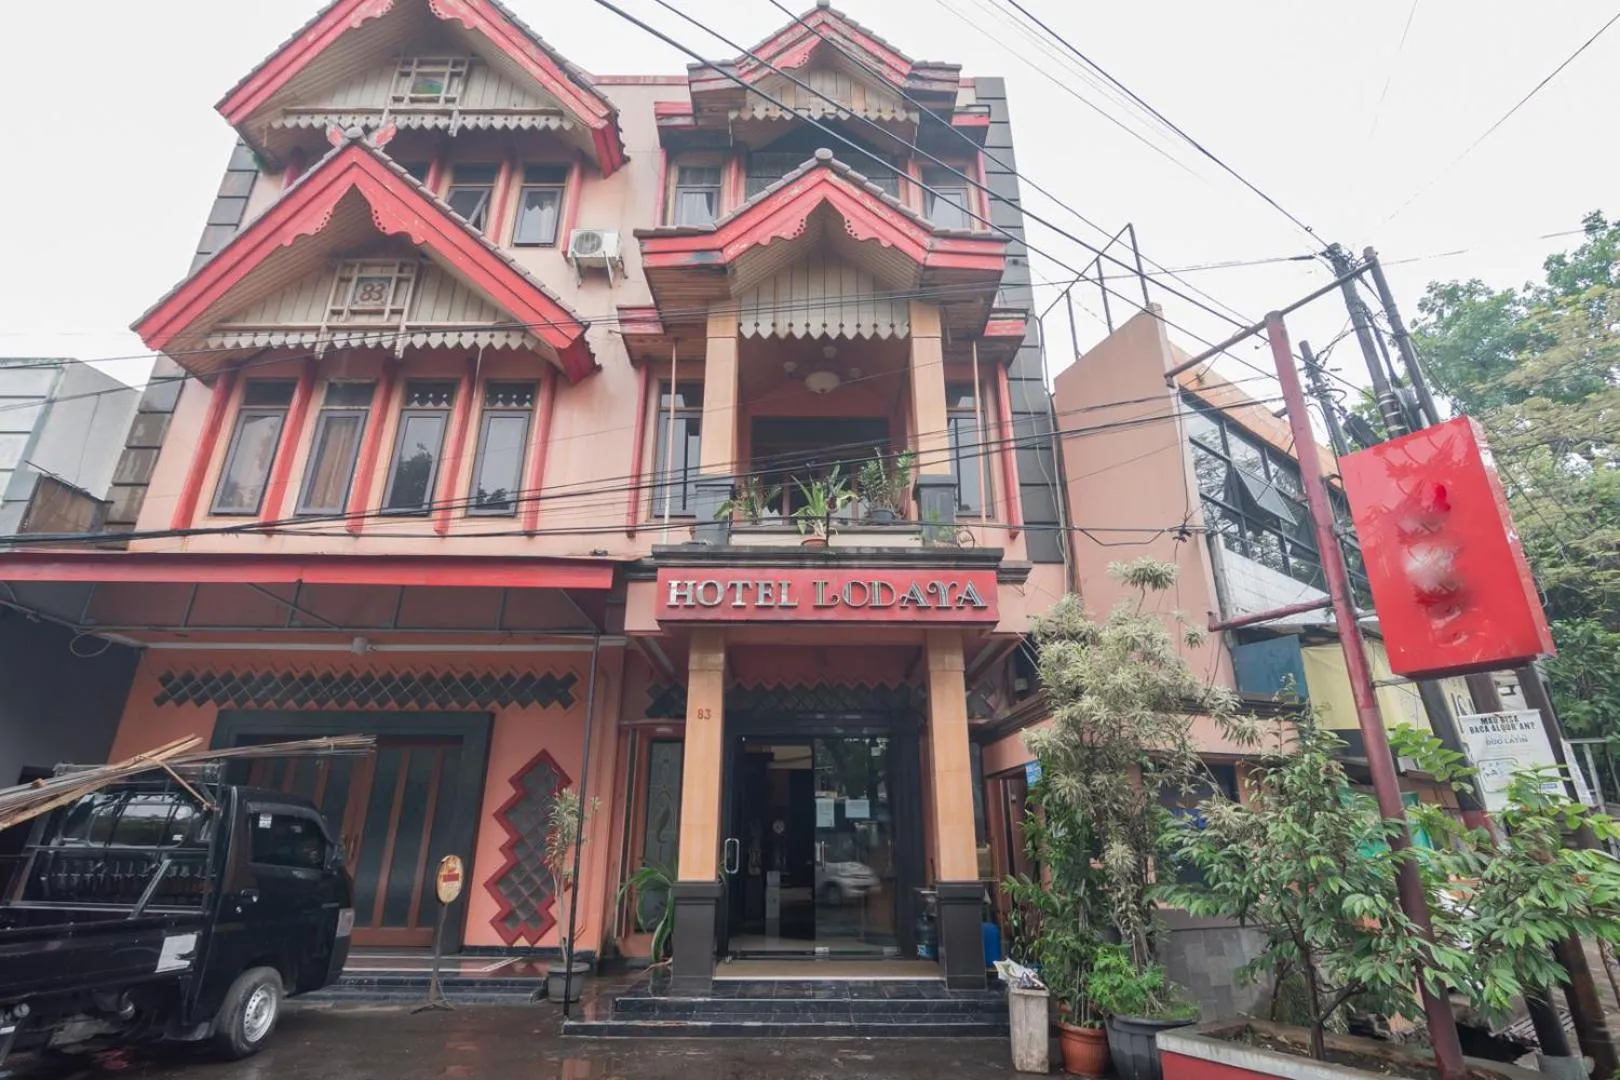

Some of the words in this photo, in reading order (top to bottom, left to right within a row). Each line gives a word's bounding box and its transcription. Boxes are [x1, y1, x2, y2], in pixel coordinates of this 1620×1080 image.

[360, 283, 386, 301] 83
[666, 580, 799, 608] HOTEL
[812, 579, 988, 609] LODAYA
[697, 708, 711, 720] 83
[1469, 724, 1490, 734] BACA
